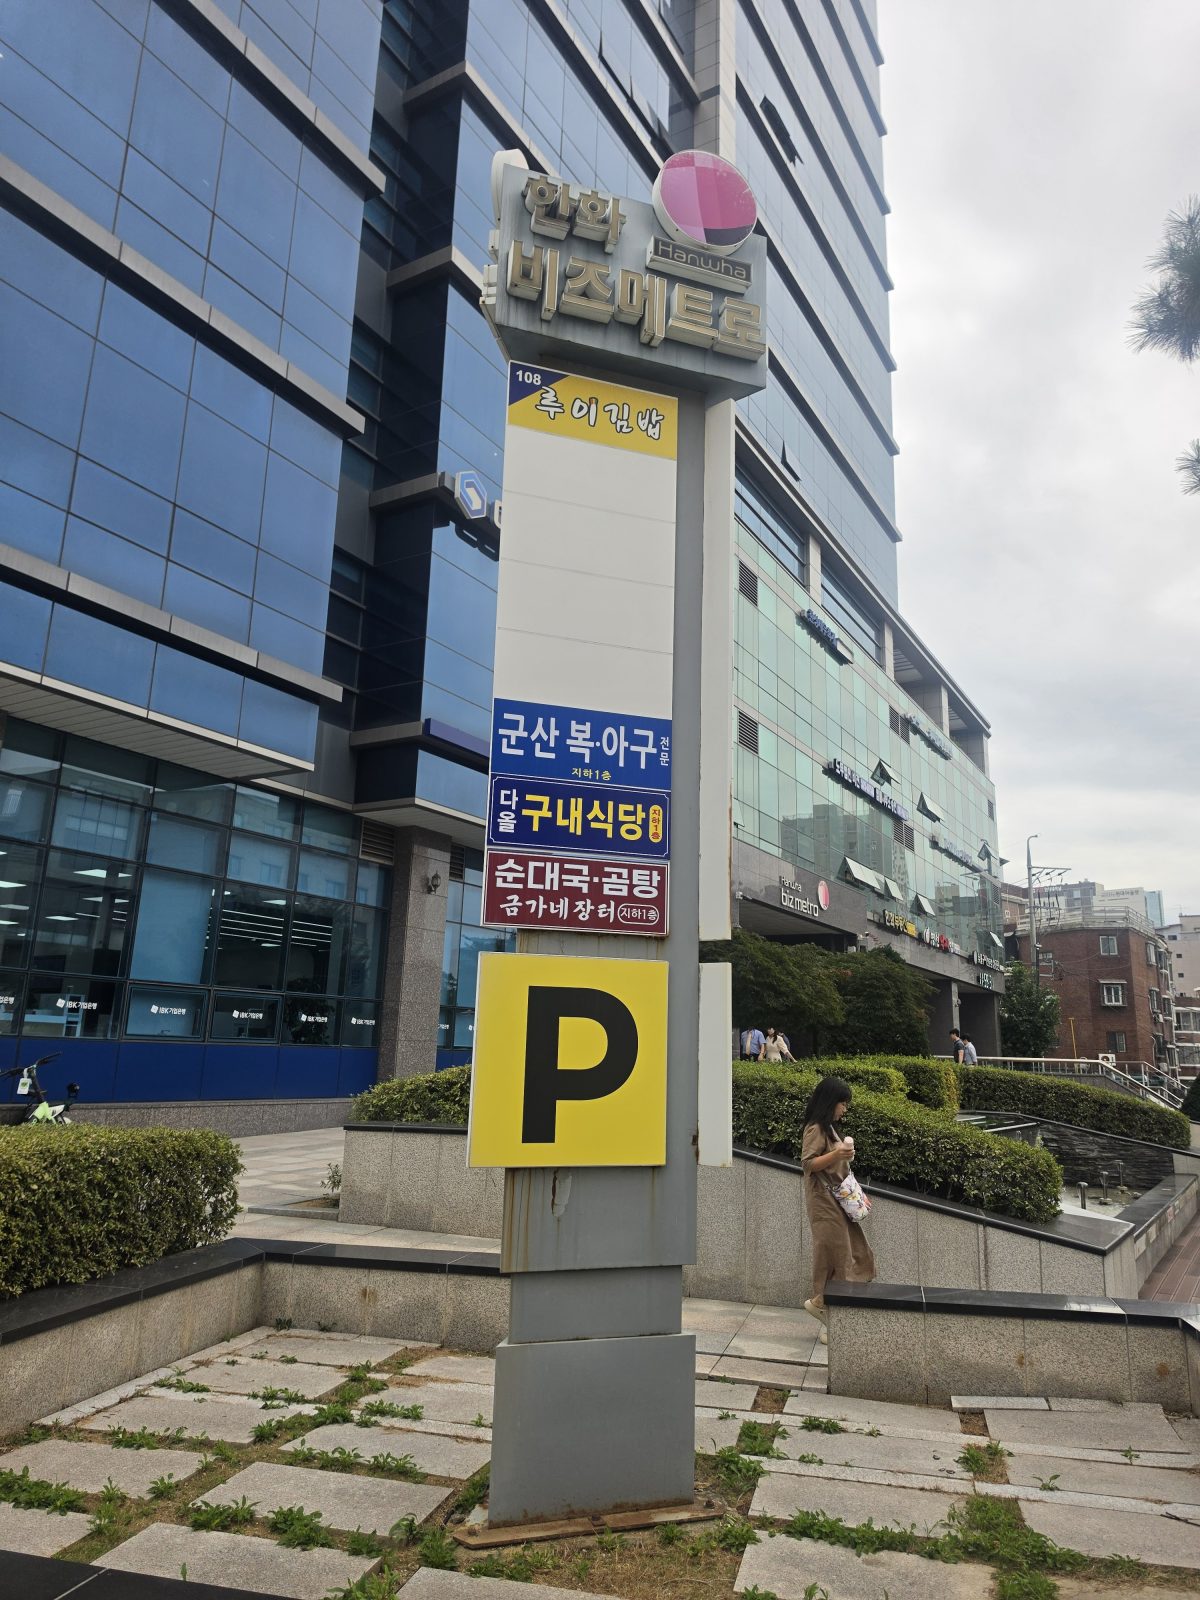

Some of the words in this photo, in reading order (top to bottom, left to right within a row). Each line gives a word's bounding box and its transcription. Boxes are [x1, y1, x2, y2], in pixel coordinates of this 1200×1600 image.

[522, 175, 626, 254] 한화
[658, 242, 746, 279] Hanwha
[507, 240, 767, 362] 비즈메트로
[516, 370, 541, 385] 108
[499, 713, 559, 759] 군산
[660, 736, 669, 766] 전문
[572, 767, 611, 780] 지하1층
[497, 789, 518, 832] 다올
[522, 794, 645, 841] 구내식당
[620, 907, 657, 920] 지하1층
[522, 985, 639, 1143] P
